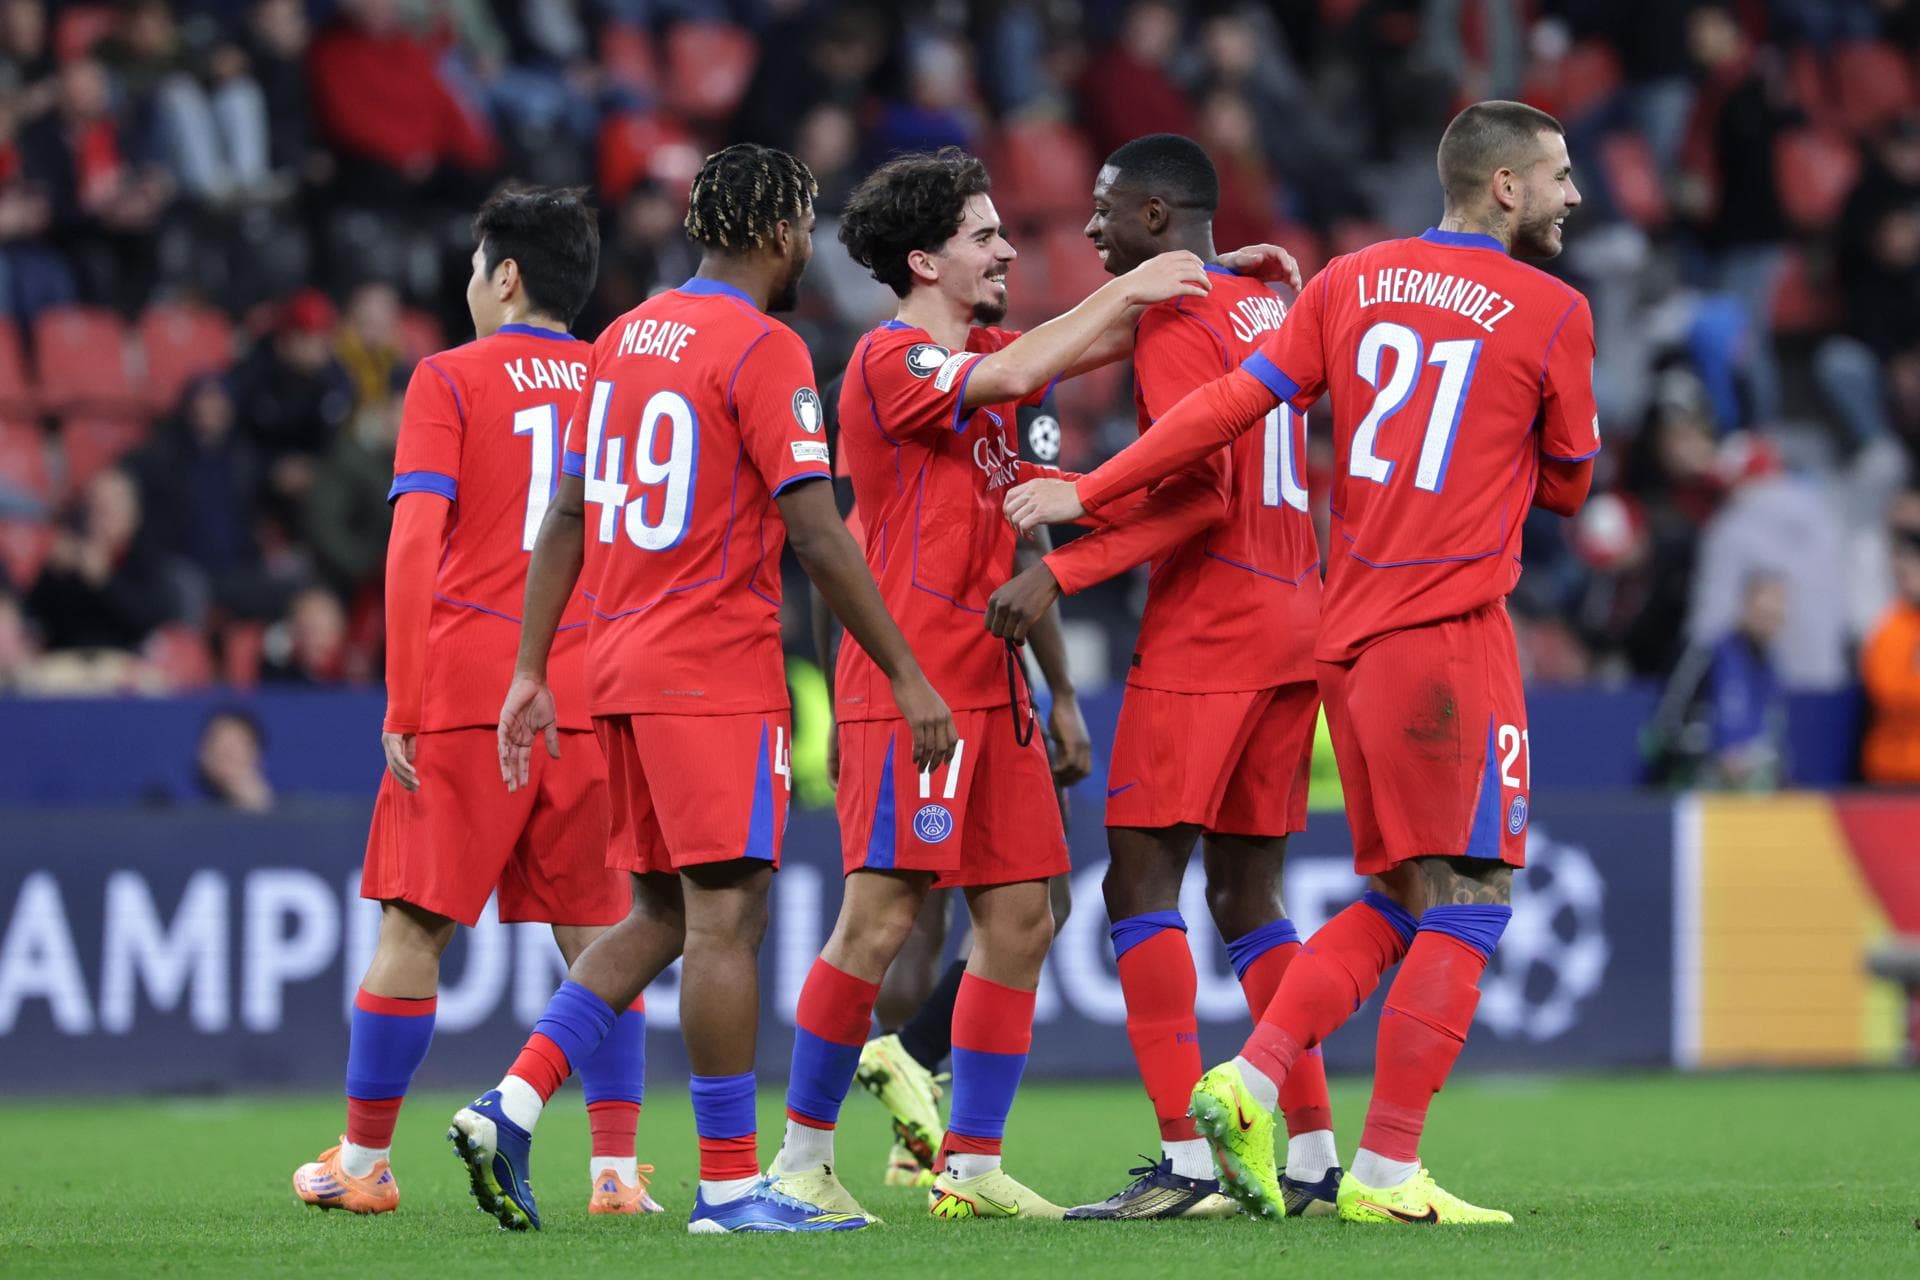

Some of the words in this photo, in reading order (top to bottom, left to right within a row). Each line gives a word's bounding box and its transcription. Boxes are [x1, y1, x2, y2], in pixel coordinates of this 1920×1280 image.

[1358, 267, 1516, 333] L.HERNANDEZ
[504, 357, 588, 393] KANG
[617, 319, 697, 364] MBAYE
[1349, 321, 1484, 494] 21
[512, 402, 574, 553] 1
[584, 379, 700, 552] 49
[1498, 724, 1531, 791] 21
